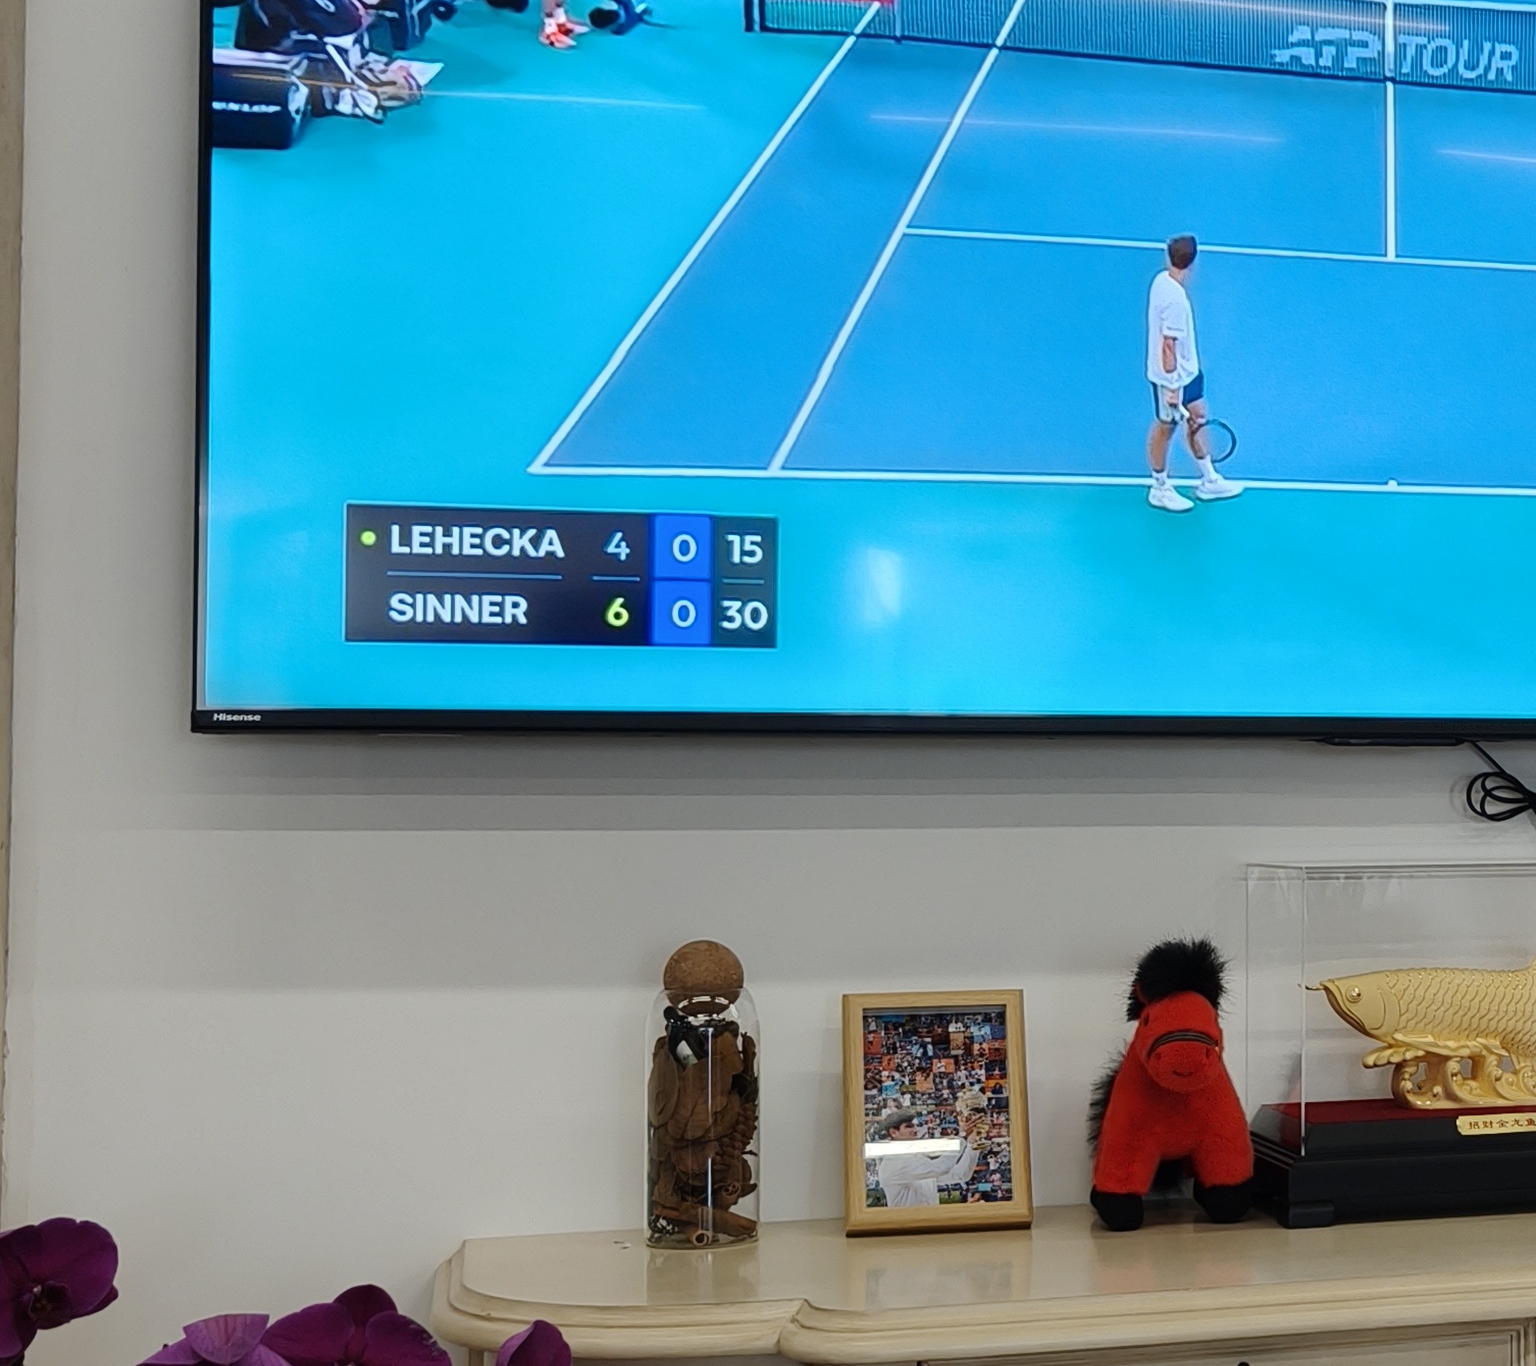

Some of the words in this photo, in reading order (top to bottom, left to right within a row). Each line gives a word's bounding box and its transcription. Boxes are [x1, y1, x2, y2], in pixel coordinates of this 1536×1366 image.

[1398, 33, 1520, 83] TOUR
[391, 524, 565, 558] LEHECKA
[604, 531, 630, 561] 4
[672, 534, 697, 563] 0
[727, 534, 763, 564] 15
[388, 593, 528, 625] SINNER
[605, 597, 630, 627] 6
[672, 600, 696, 629] 0
[721, 600, 768, 630] 30
[212, 712, 262, 723] Hisense
